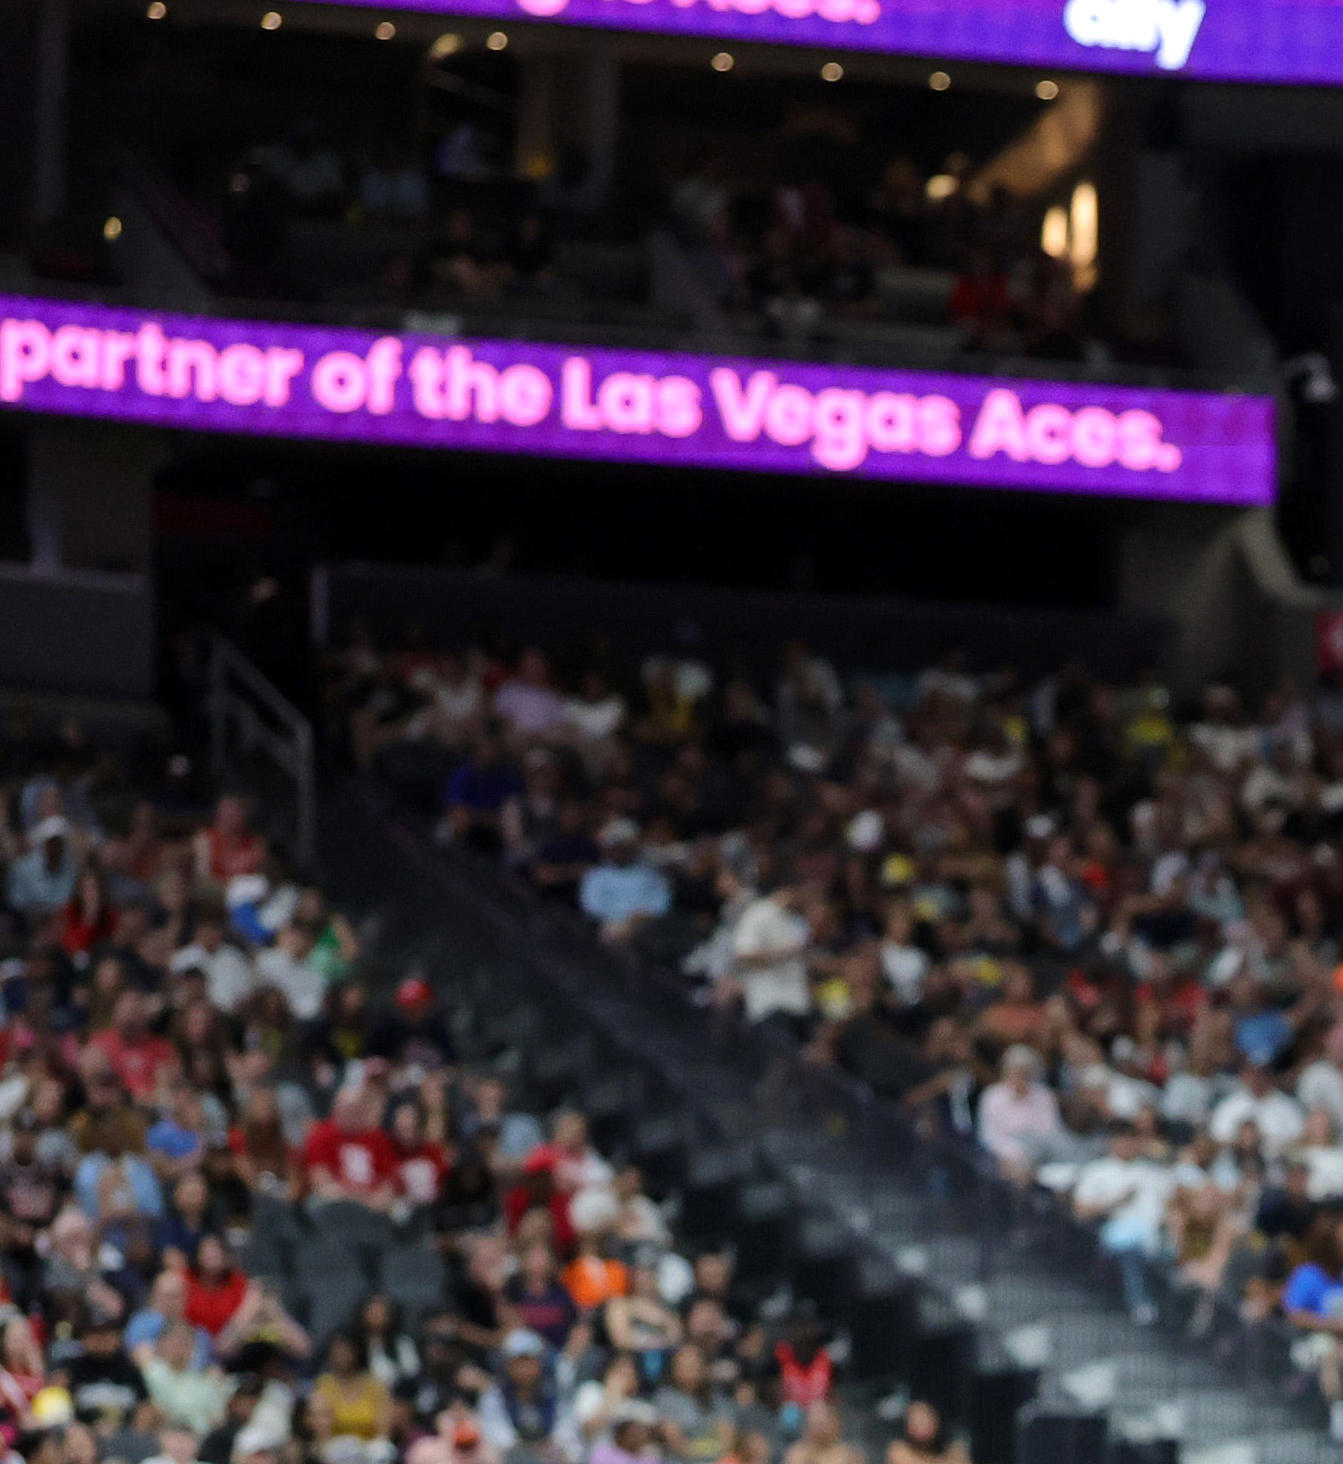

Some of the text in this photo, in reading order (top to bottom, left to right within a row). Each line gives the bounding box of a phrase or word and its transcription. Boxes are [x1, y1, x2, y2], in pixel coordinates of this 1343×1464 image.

[1, 318, 1181, 472] partner of the Las Vegas Aces.
